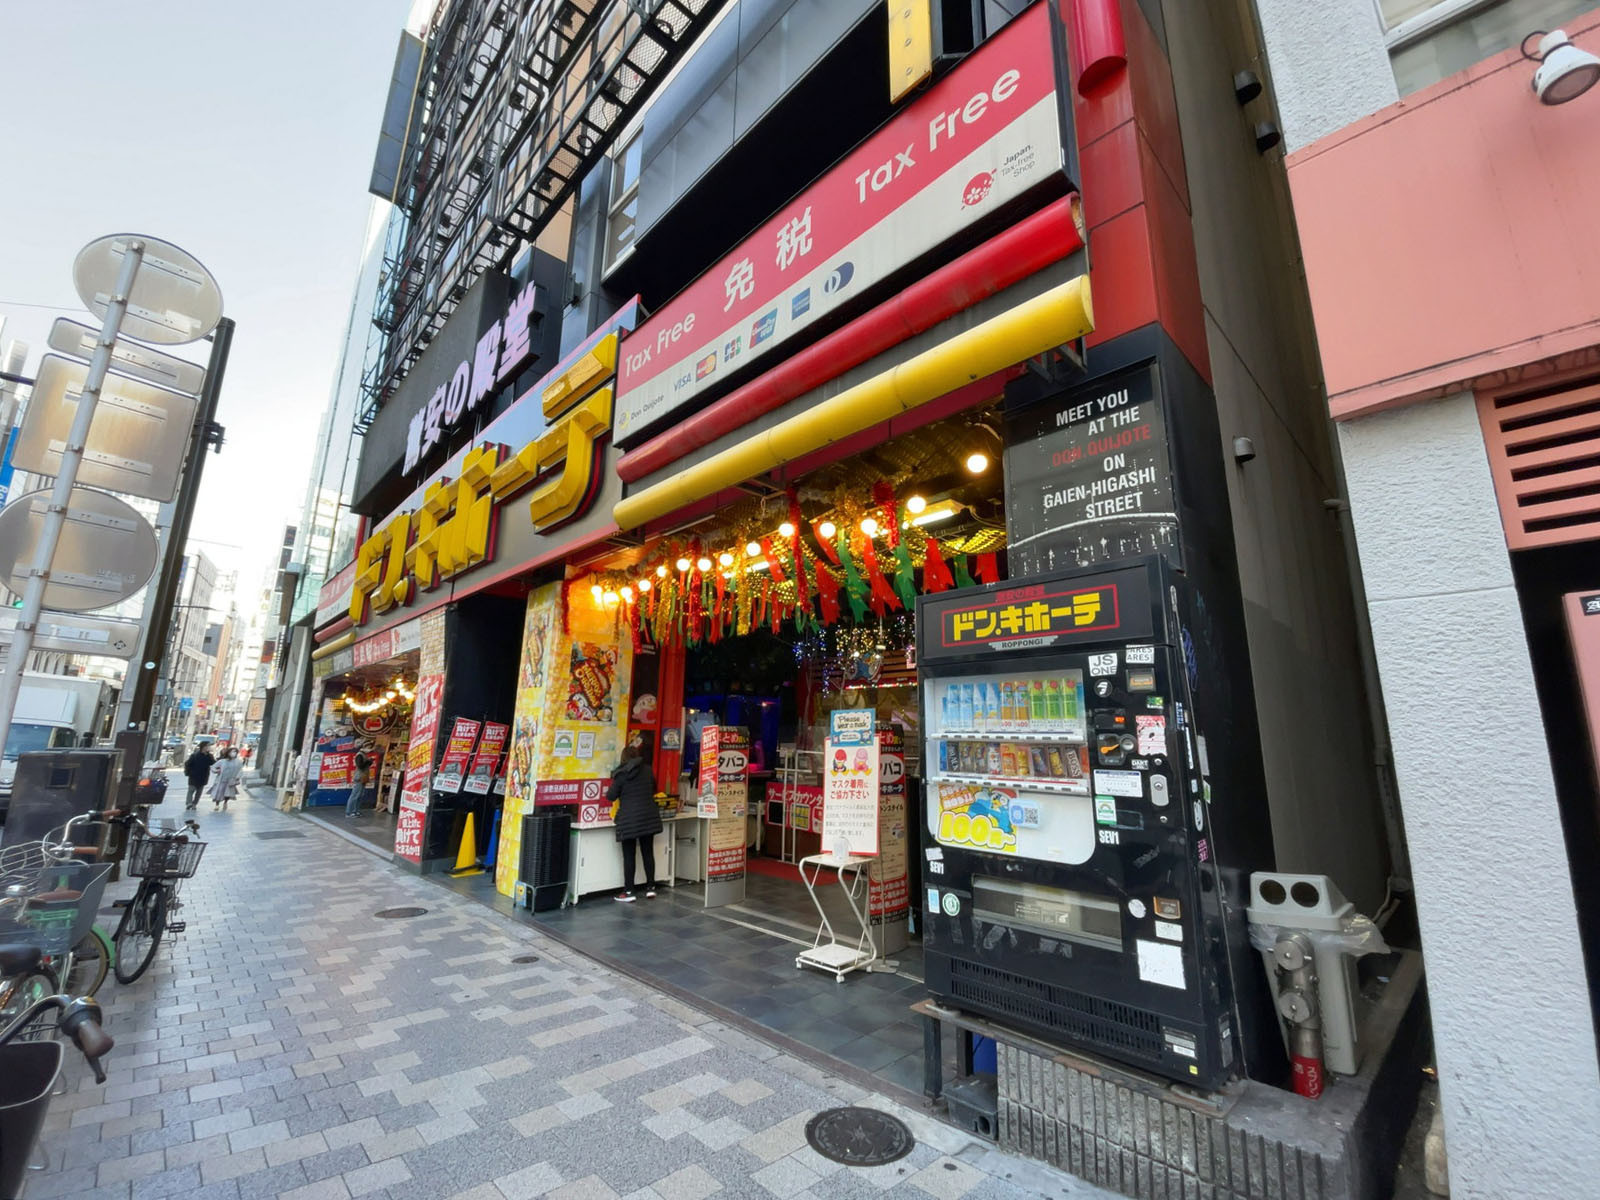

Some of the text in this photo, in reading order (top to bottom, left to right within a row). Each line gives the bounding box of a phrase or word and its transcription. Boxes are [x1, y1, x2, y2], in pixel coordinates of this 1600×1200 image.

[855, 69, 1021, 203] Tax Free
[1012, 160, 1036, 178] Shop
[723, 206, 813, 313] 免税
[625, 312, 696, 377] Tax Free
[673, 372, 692, 392] VISA
[1055, 388, 1129, 427] MEET YOU
[1088, 406, 1140, 436] AT THE
[1087, 424, 1152, 457] QUIJOTE
[1103, 453, 1126, 472] ON
[1043, 466, 1156, 509] GAIEN-HIGASHI
[1085, 491, 1144, 519] STREET
[1001, 637, 1044, 649] ROPPONGI
[1091, 666, 1117, 675] ONE
[1093, 654, 1114, 667] JS
[1066, 750, 1081, 778] BOSS
[831, 779, 869, 789] マスク着用に
[831, 789, 870, 799] ご協力下さい
